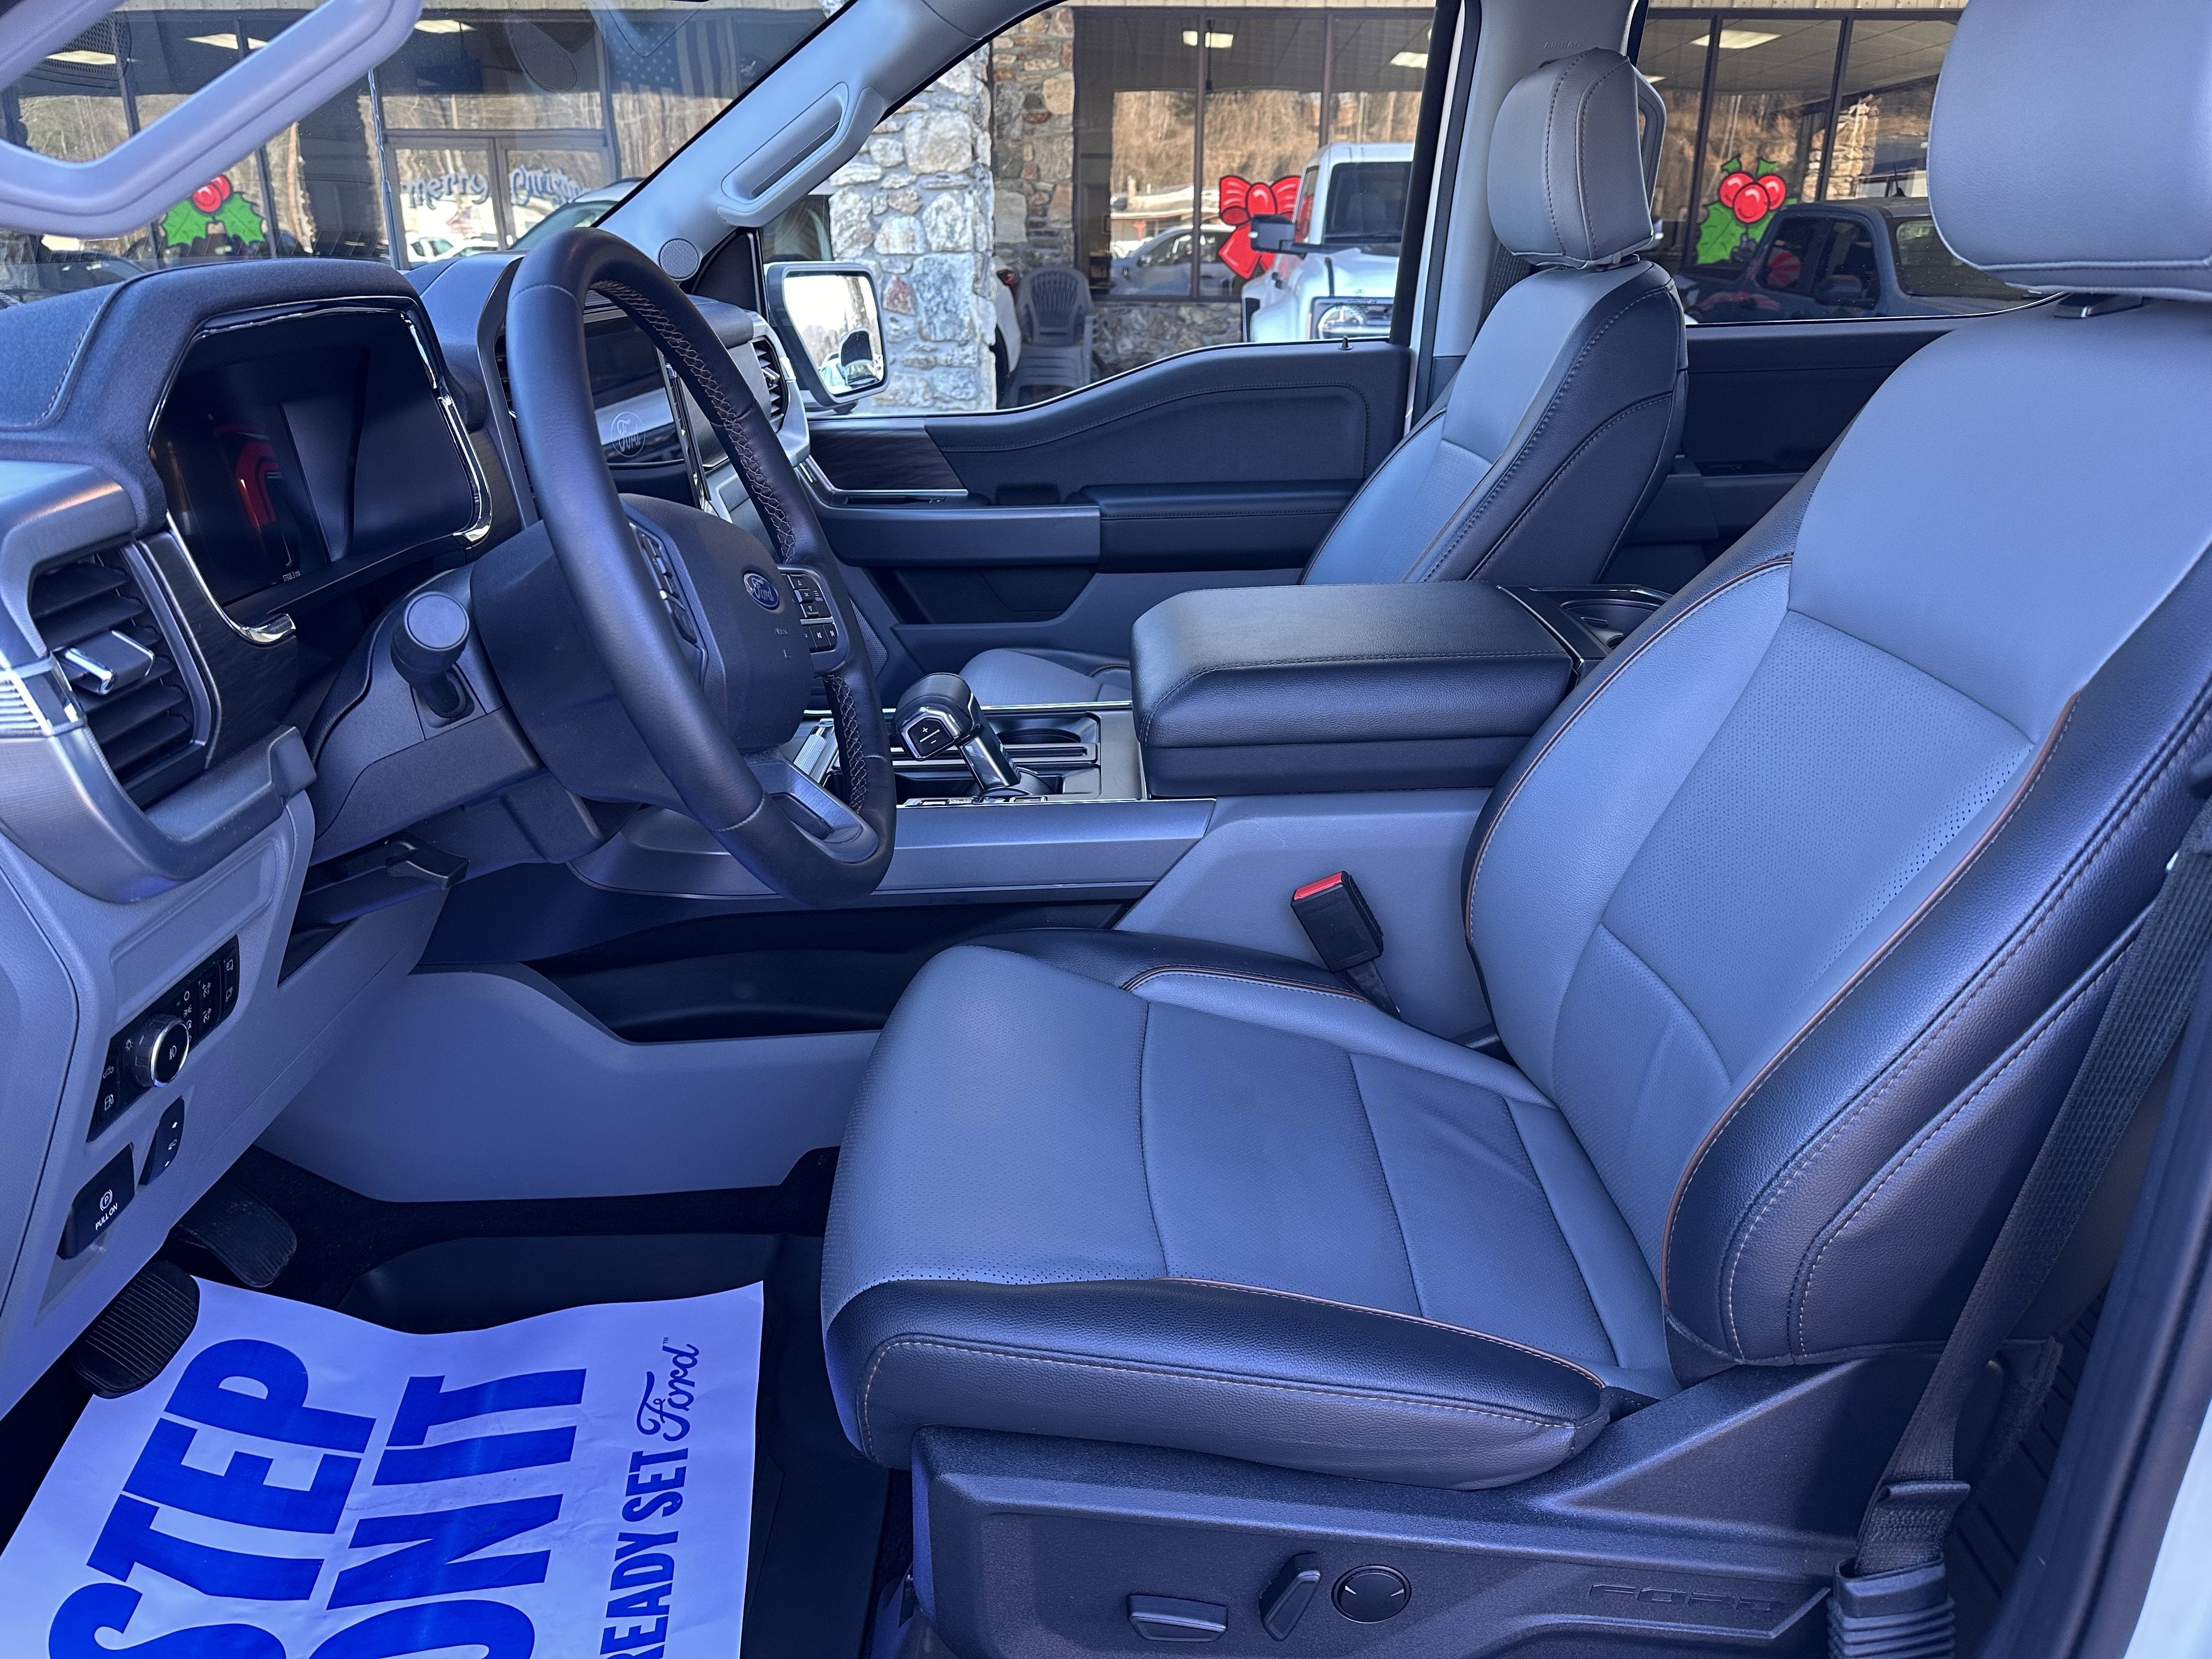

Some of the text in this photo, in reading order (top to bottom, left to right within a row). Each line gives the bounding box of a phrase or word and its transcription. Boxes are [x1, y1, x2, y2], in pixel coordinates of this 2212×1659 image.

[617, 419, 641, 452] Ford
[751, 578, 774, 601] Ford
[95, 1202, 117, 1230] PULL ON
[636, 1344, 699, 1441] Ford
[373, 1368, 586, 1485] IT
[48, 1339, 377, 1659] STEP
[622, 1447, 689, 1522] SET
[1589, 1584, 1782, 1611] FORD
